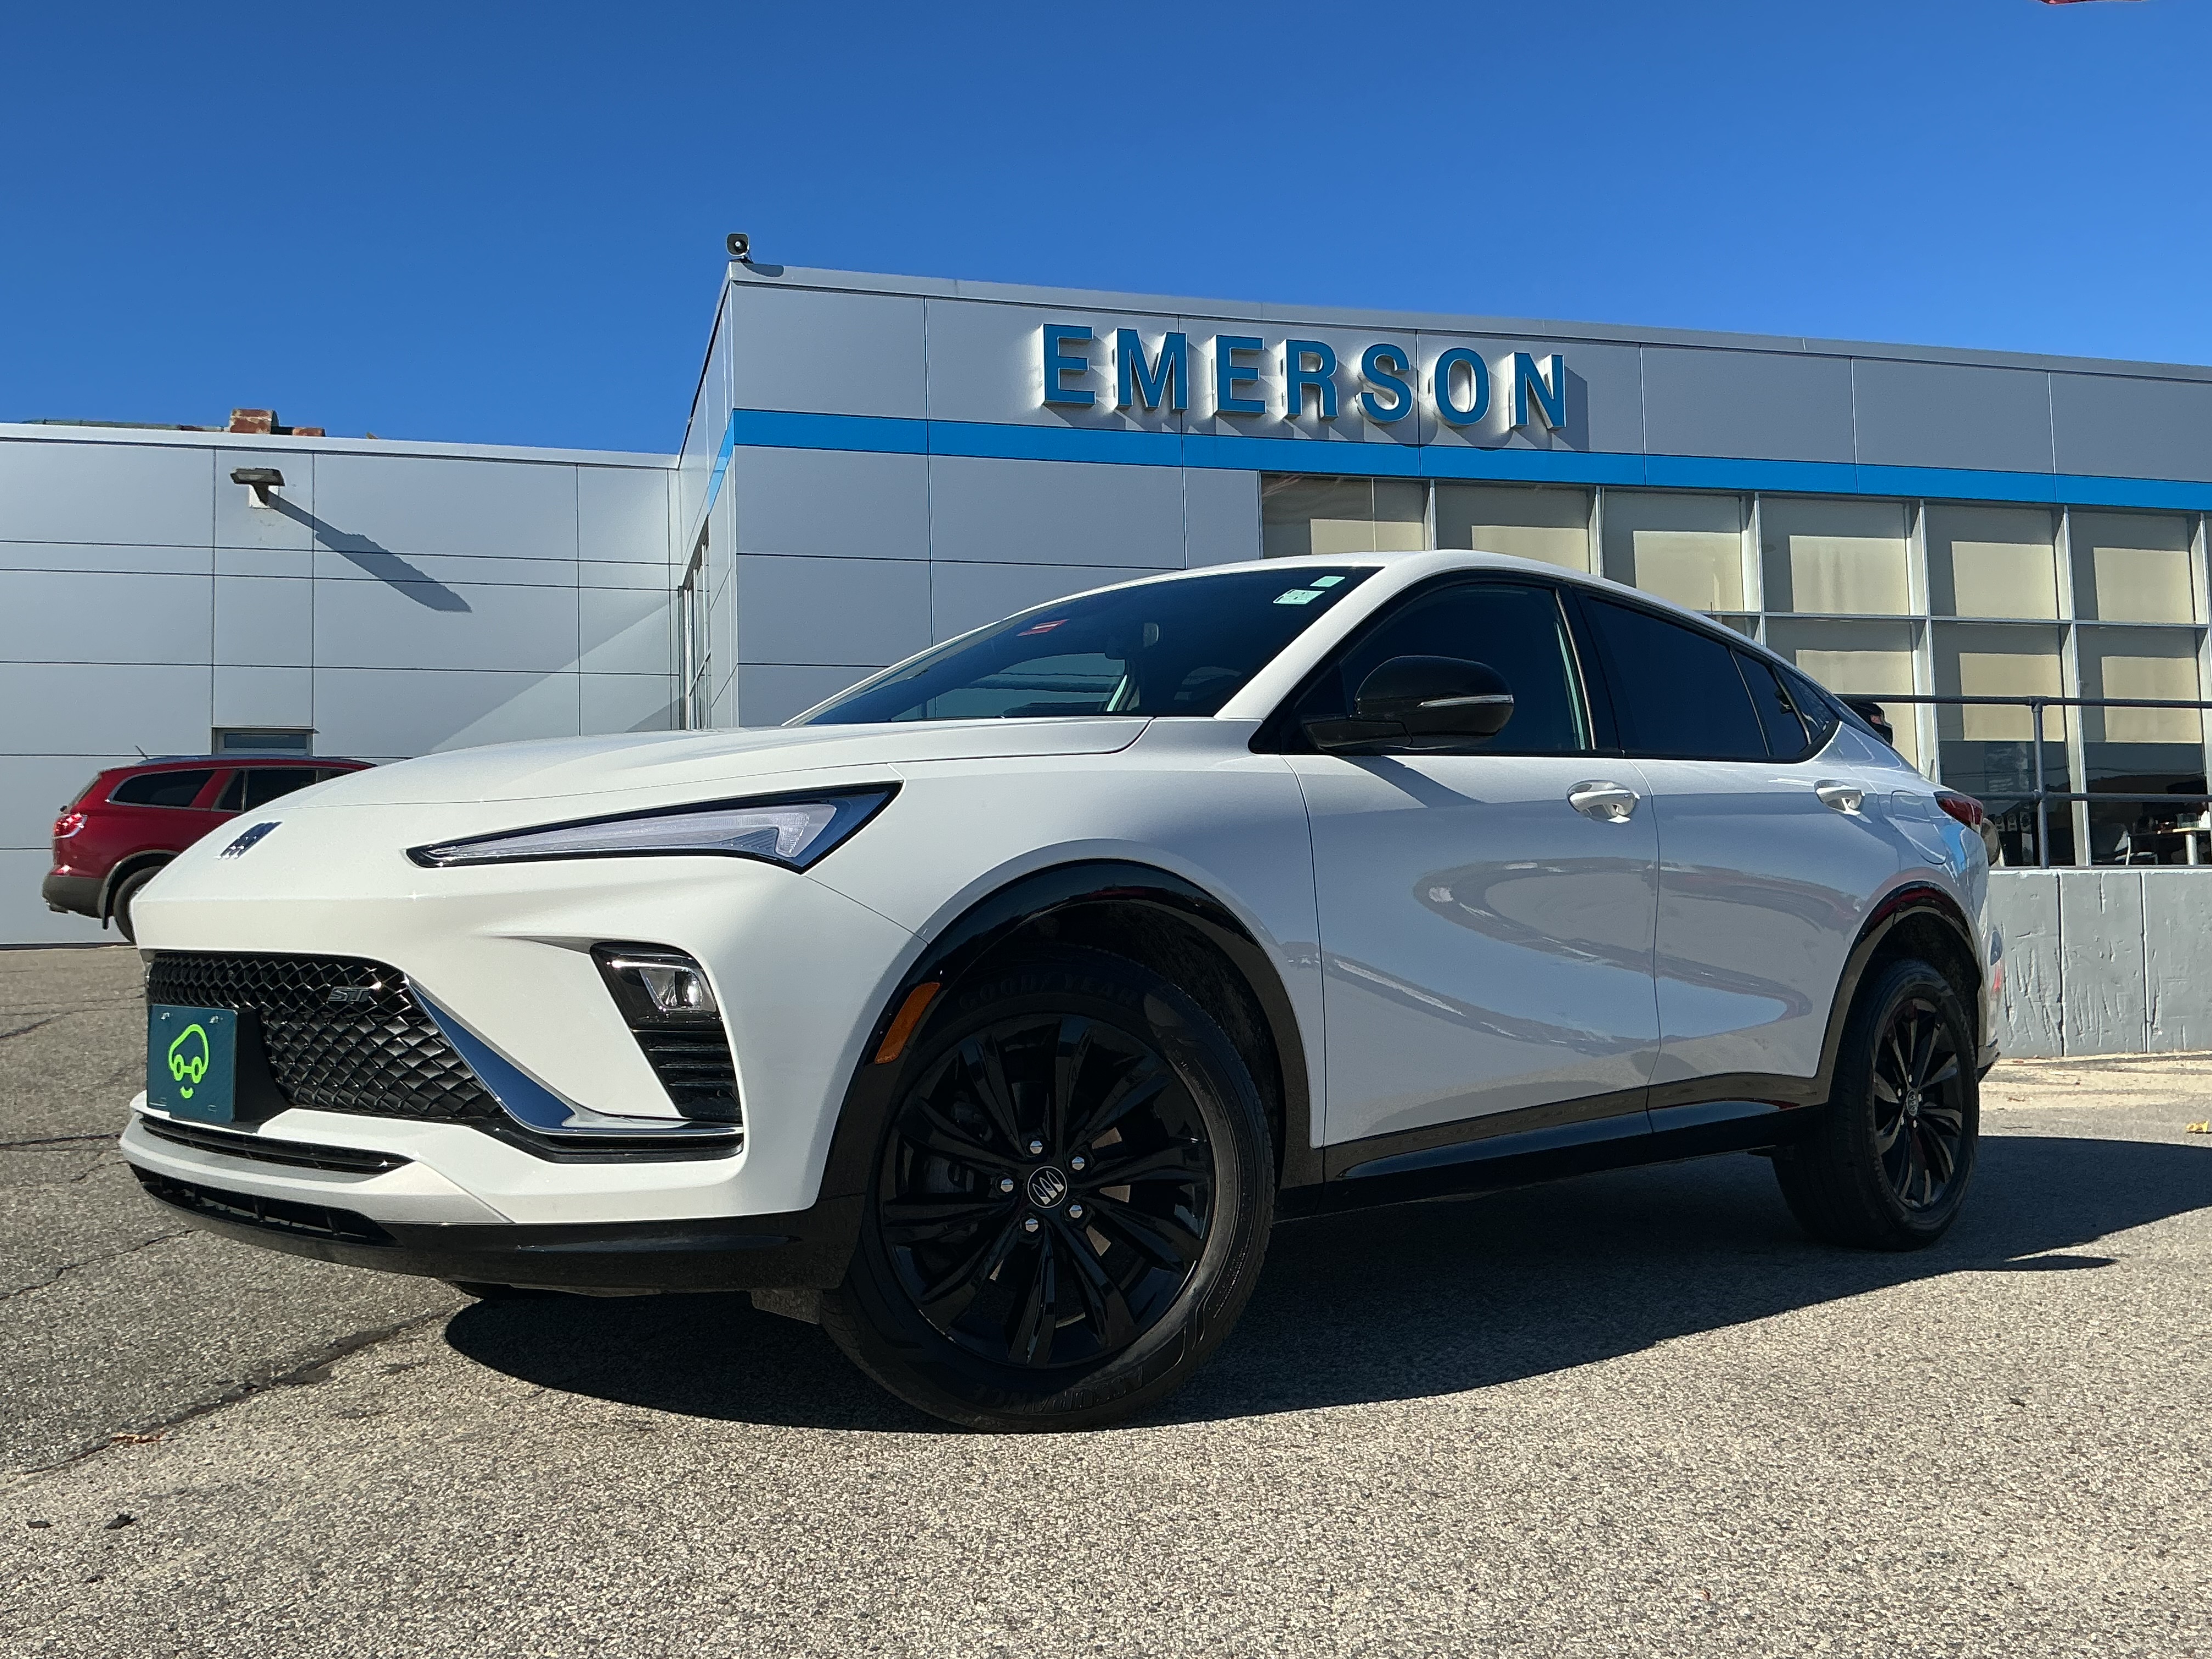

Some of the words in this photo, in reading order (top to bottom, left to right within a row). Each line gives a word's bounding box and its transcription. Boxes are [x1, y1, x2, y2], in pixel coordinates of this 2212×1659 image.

[1042, 323, 1566, 430] EMERSON
[328, 986, 371, 1002] ST
[961, 972, 1138, 1010] GOODYEAR
